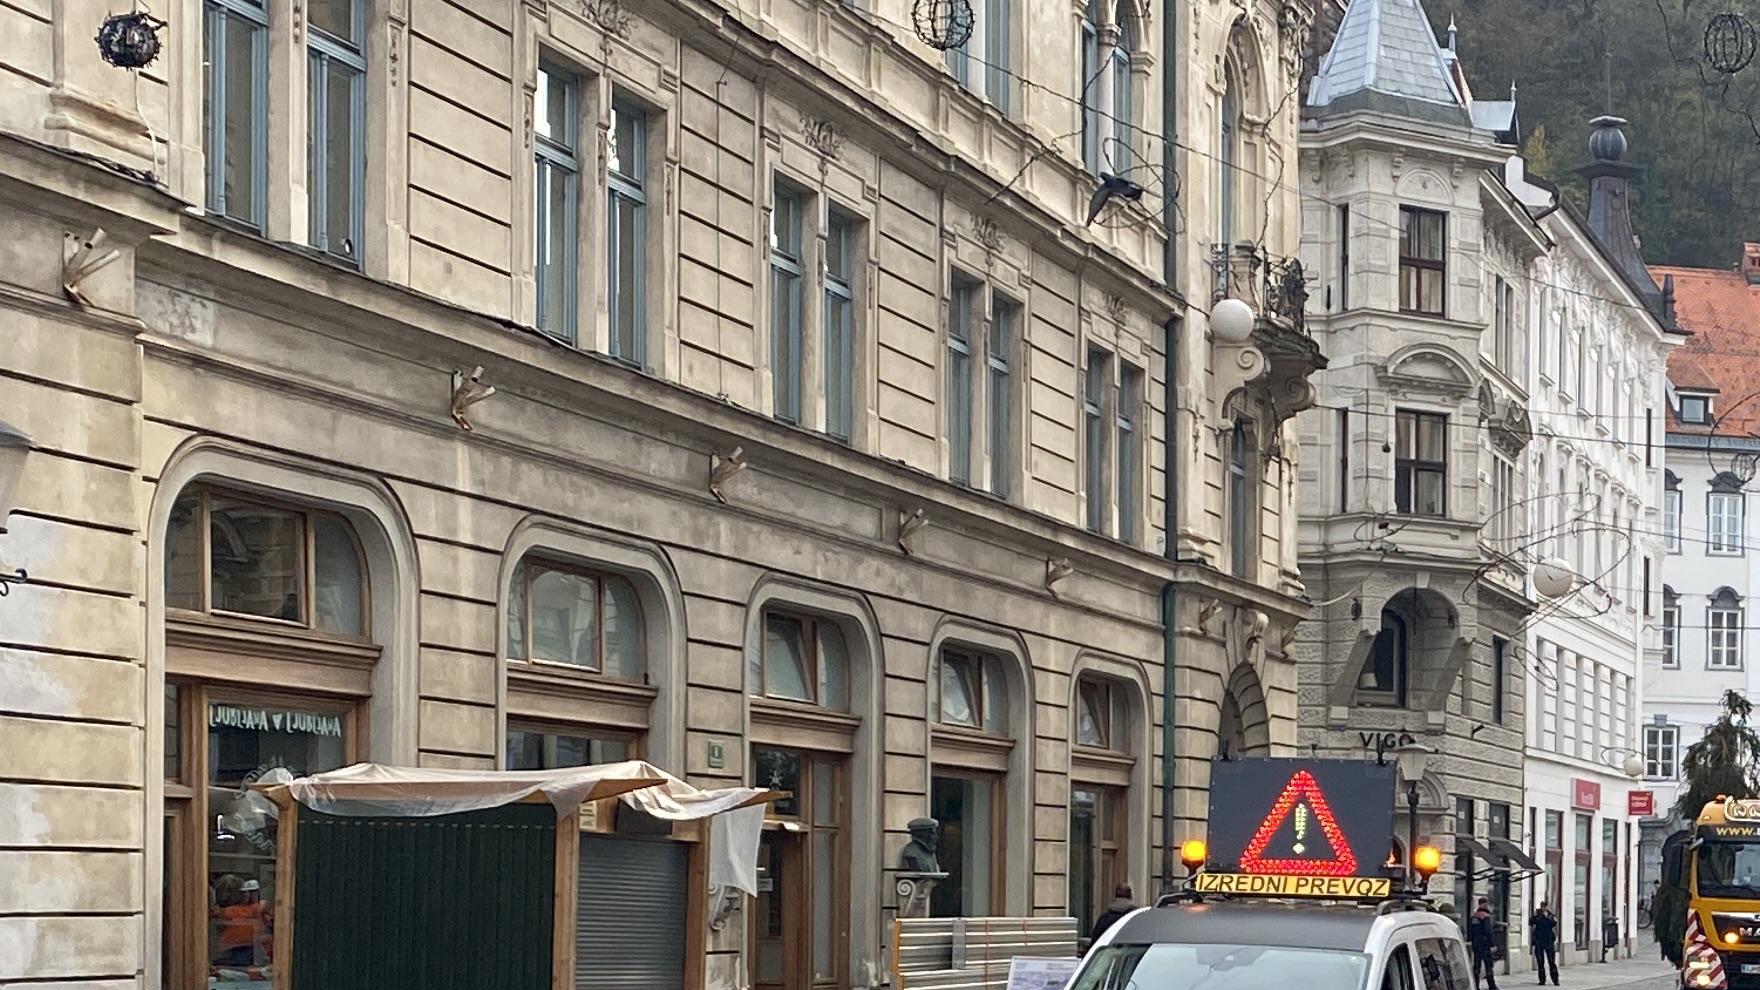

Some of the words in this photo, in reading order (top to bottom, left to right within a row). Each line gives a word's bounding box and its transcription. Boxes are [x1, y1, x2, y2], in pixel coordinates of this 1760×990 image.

[209, 705, 268, 732] LJUBLJANA
[286, 711, 341, 737] LJUBLJANA
[1199, 875, 1289, 893] IZREDNI
[1294, 877, 1389, 897] PREVOZ
